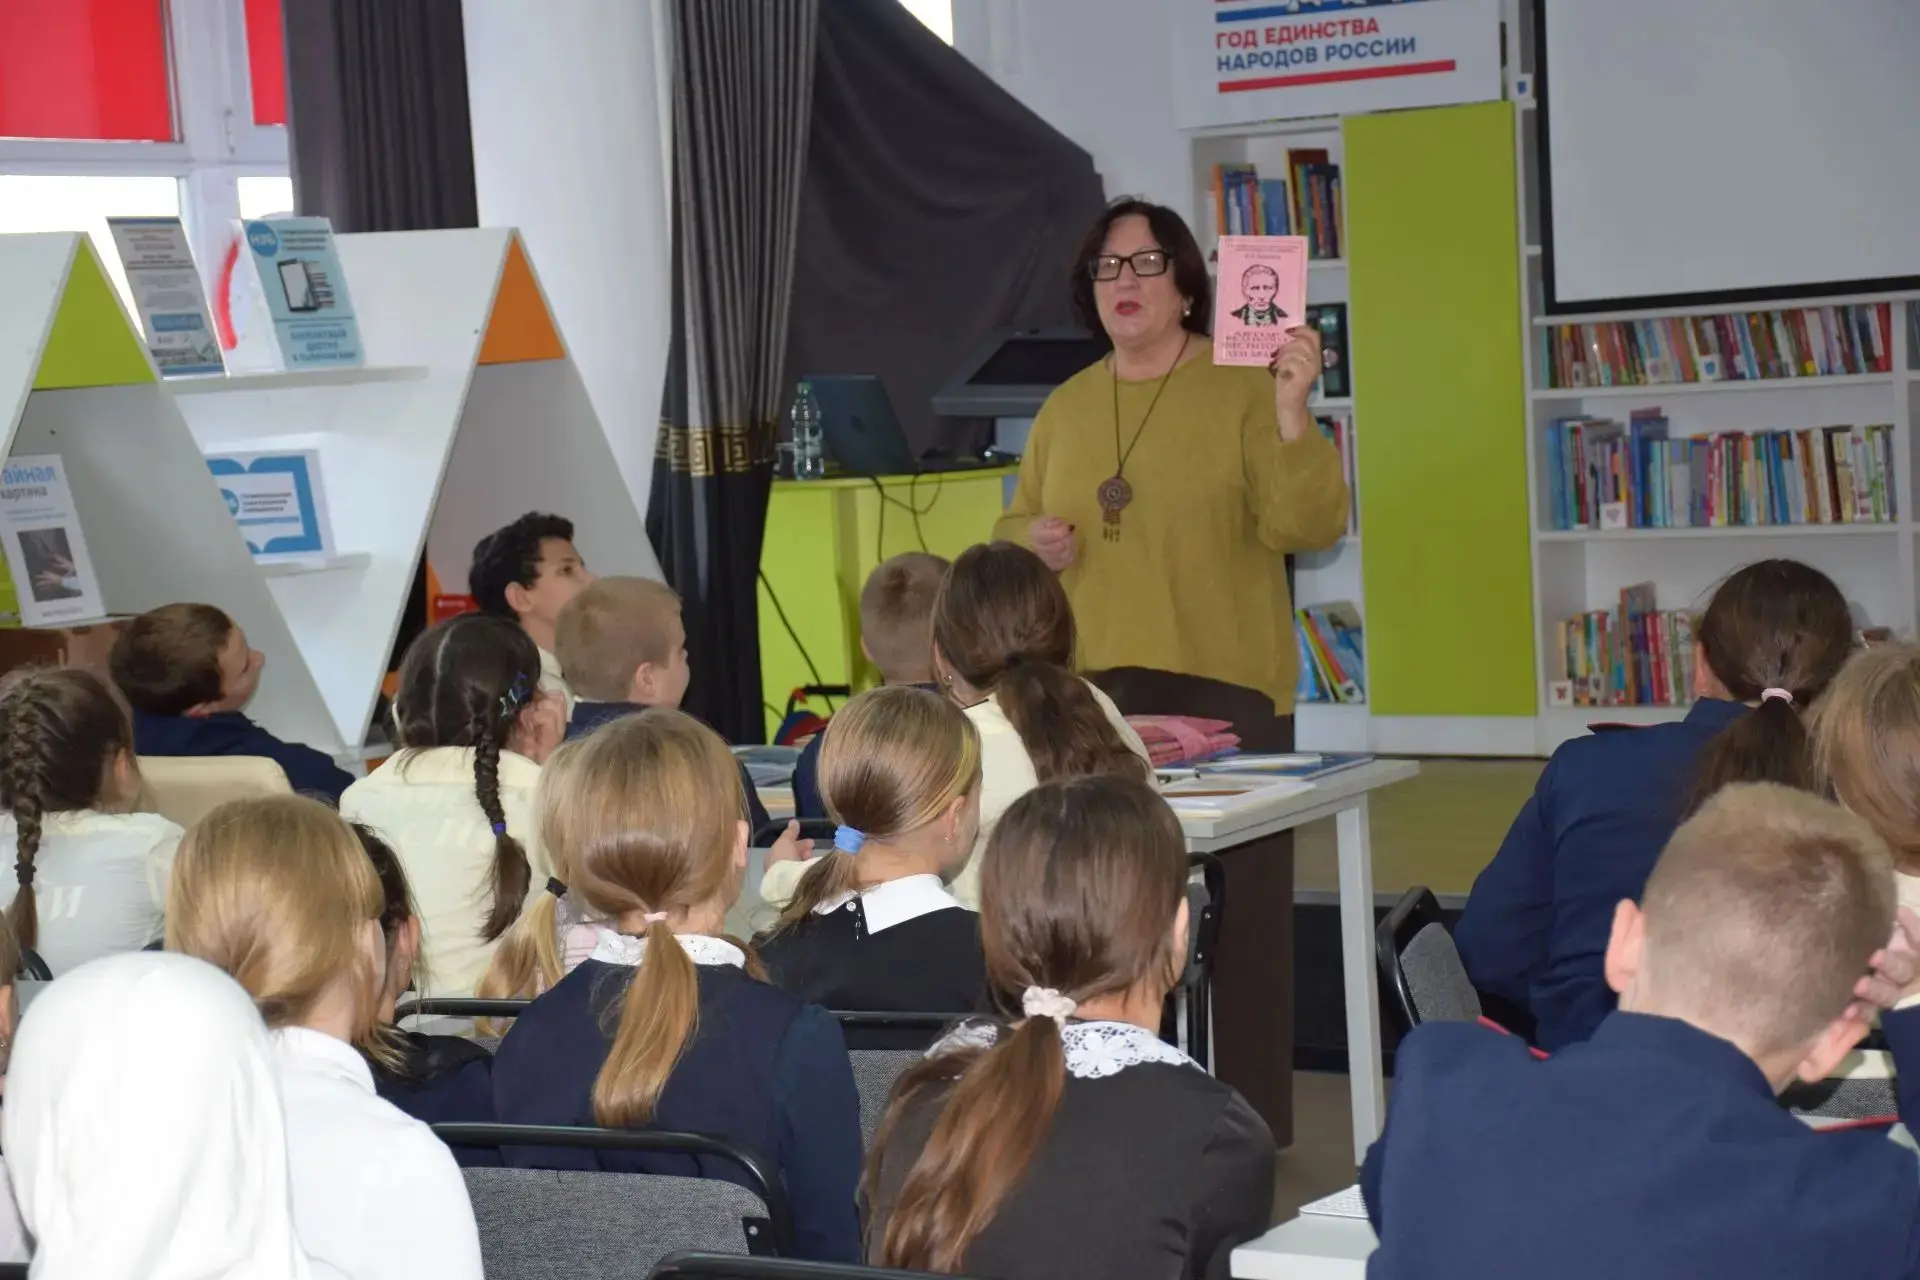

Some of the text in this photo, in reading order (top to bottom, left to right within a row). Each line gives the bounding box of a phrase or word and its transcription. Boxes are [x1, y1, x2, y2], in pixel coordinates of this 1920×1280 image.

[1216, 17, 1380, 49] ГОД ЕДИНСТВА
[1217, 36, 1416, 72] НАРОДОВ РОССИИ
[2, 464, 58, 485] айная
